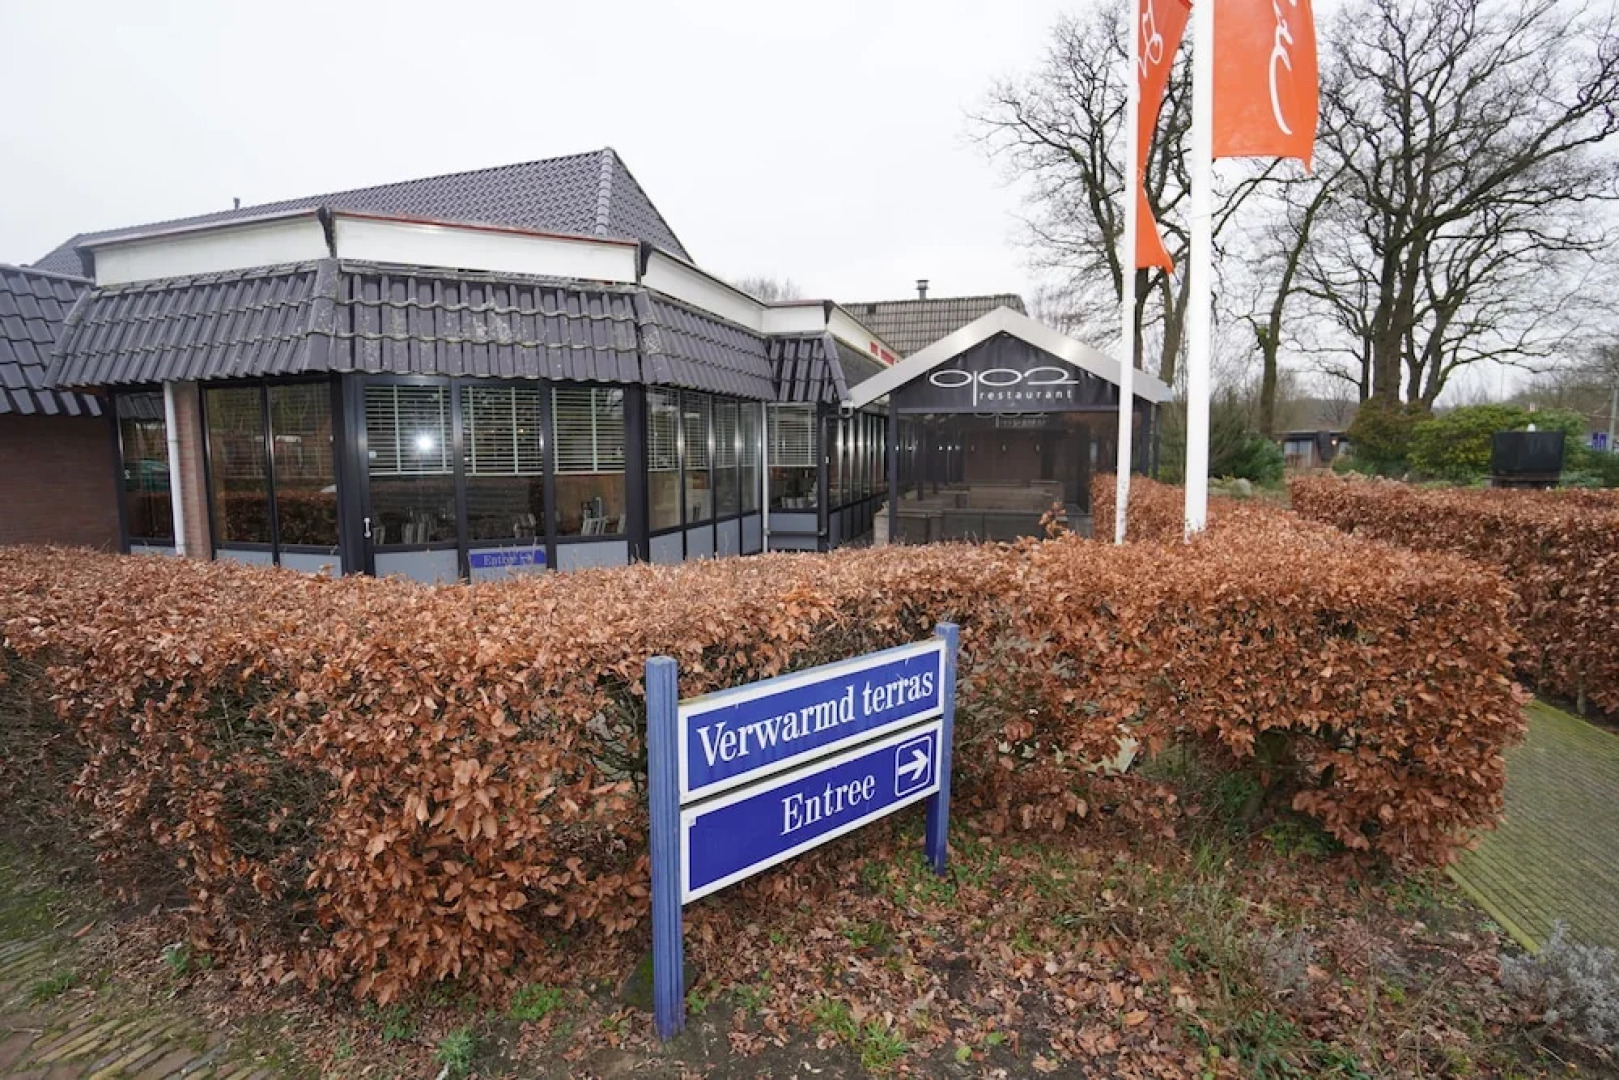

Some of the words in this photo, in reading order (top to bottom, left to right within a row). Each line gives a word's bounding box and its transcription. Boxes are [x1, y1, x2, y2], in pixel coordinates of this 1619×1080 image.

[979, 389, 1073, 401] restaurant
[697, 686, 855, 766] Verwarmd
[862, 671, 934, 715] terras
[781, 774, 876, 835] Entree
